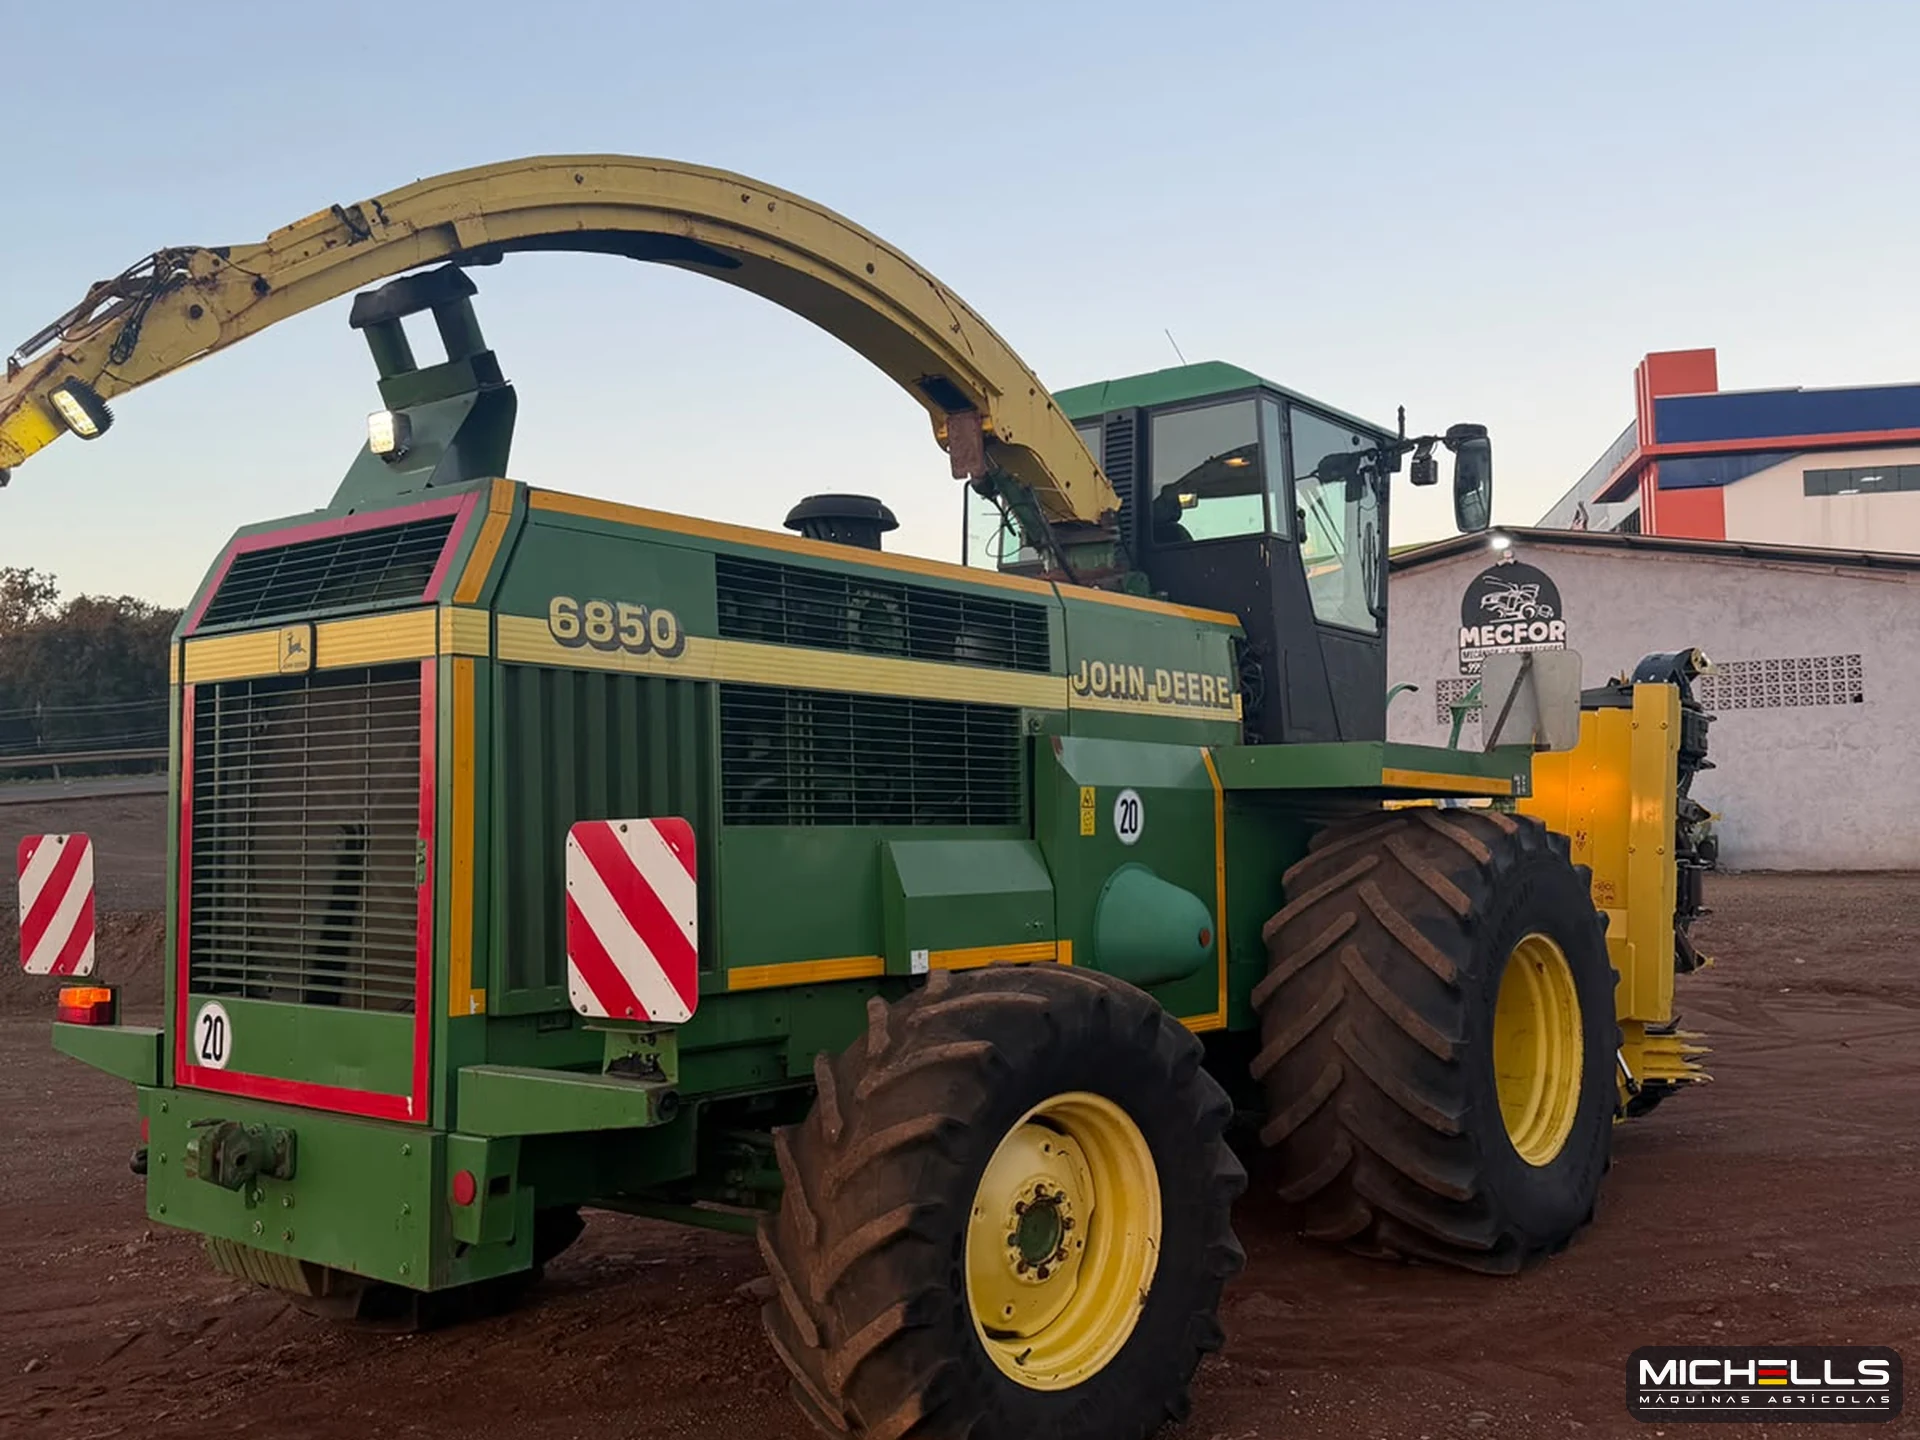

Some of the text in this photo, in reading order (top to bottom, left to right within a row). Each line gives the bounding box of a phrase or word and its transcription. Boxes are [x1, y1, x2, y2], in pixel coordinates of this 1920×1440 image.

[549, 596, 685, 658] 6850
[1460, 620, 1567, 648] MECFOR
[1072, 660, 1232, 707] JOHN DEERE
[1120, 798, 1138, 834] 20
[202, 1013, 224, 1062] 20
